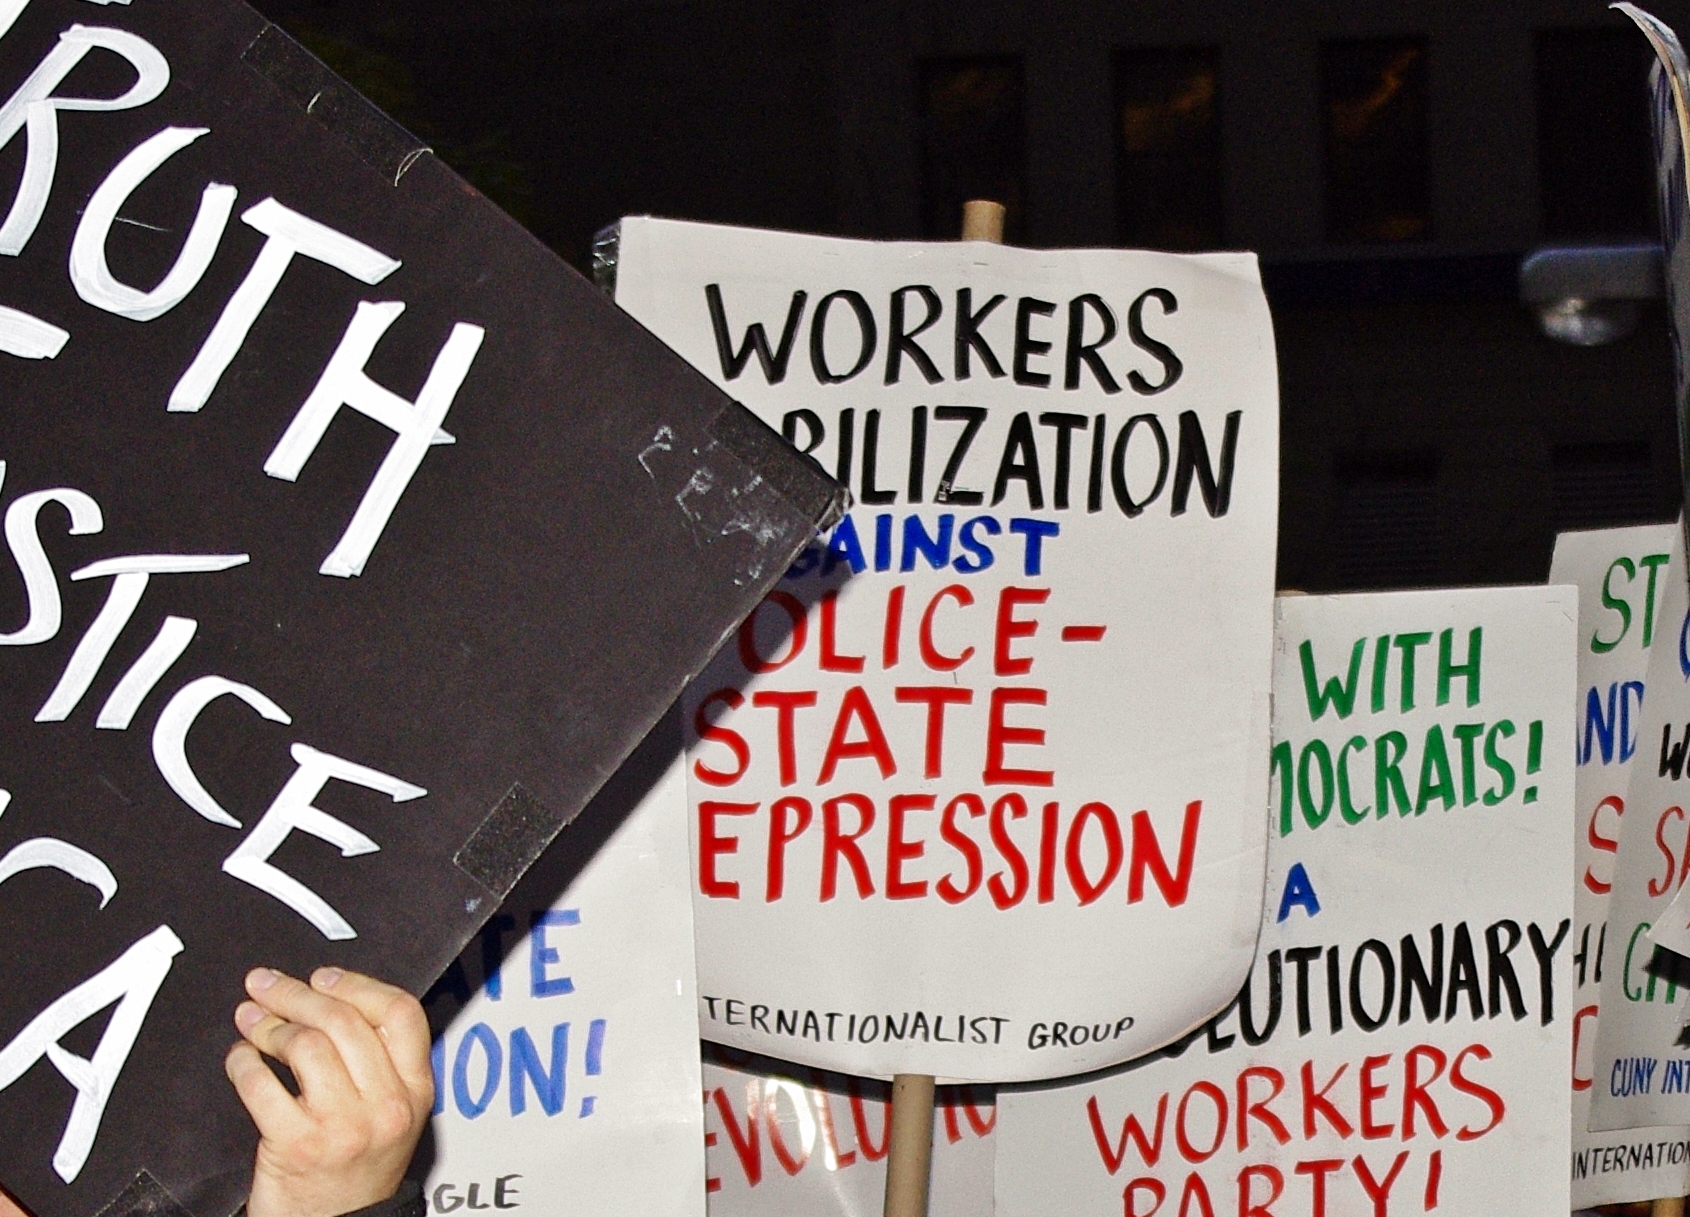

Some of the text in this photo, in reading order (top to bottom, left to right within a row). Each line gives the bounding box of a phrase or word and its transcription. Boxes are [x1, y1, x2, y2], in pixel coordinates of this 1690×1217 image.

[0, 22, 485, 577] RUTH
[704, 284, 1184, 396] WORKERS
[0, 460, 428, 940] STICE
[1299, 626, 1483, 721] WITH
[693, 685, 1056, 788] STATE
[1277, 862, 1321, 924] A
[1027, 1015, 1135, 1051] GROUP
[1611, 1058, 1657, 1097] CUNY
[1086, 1042, 1508, 1177] WORKERS
